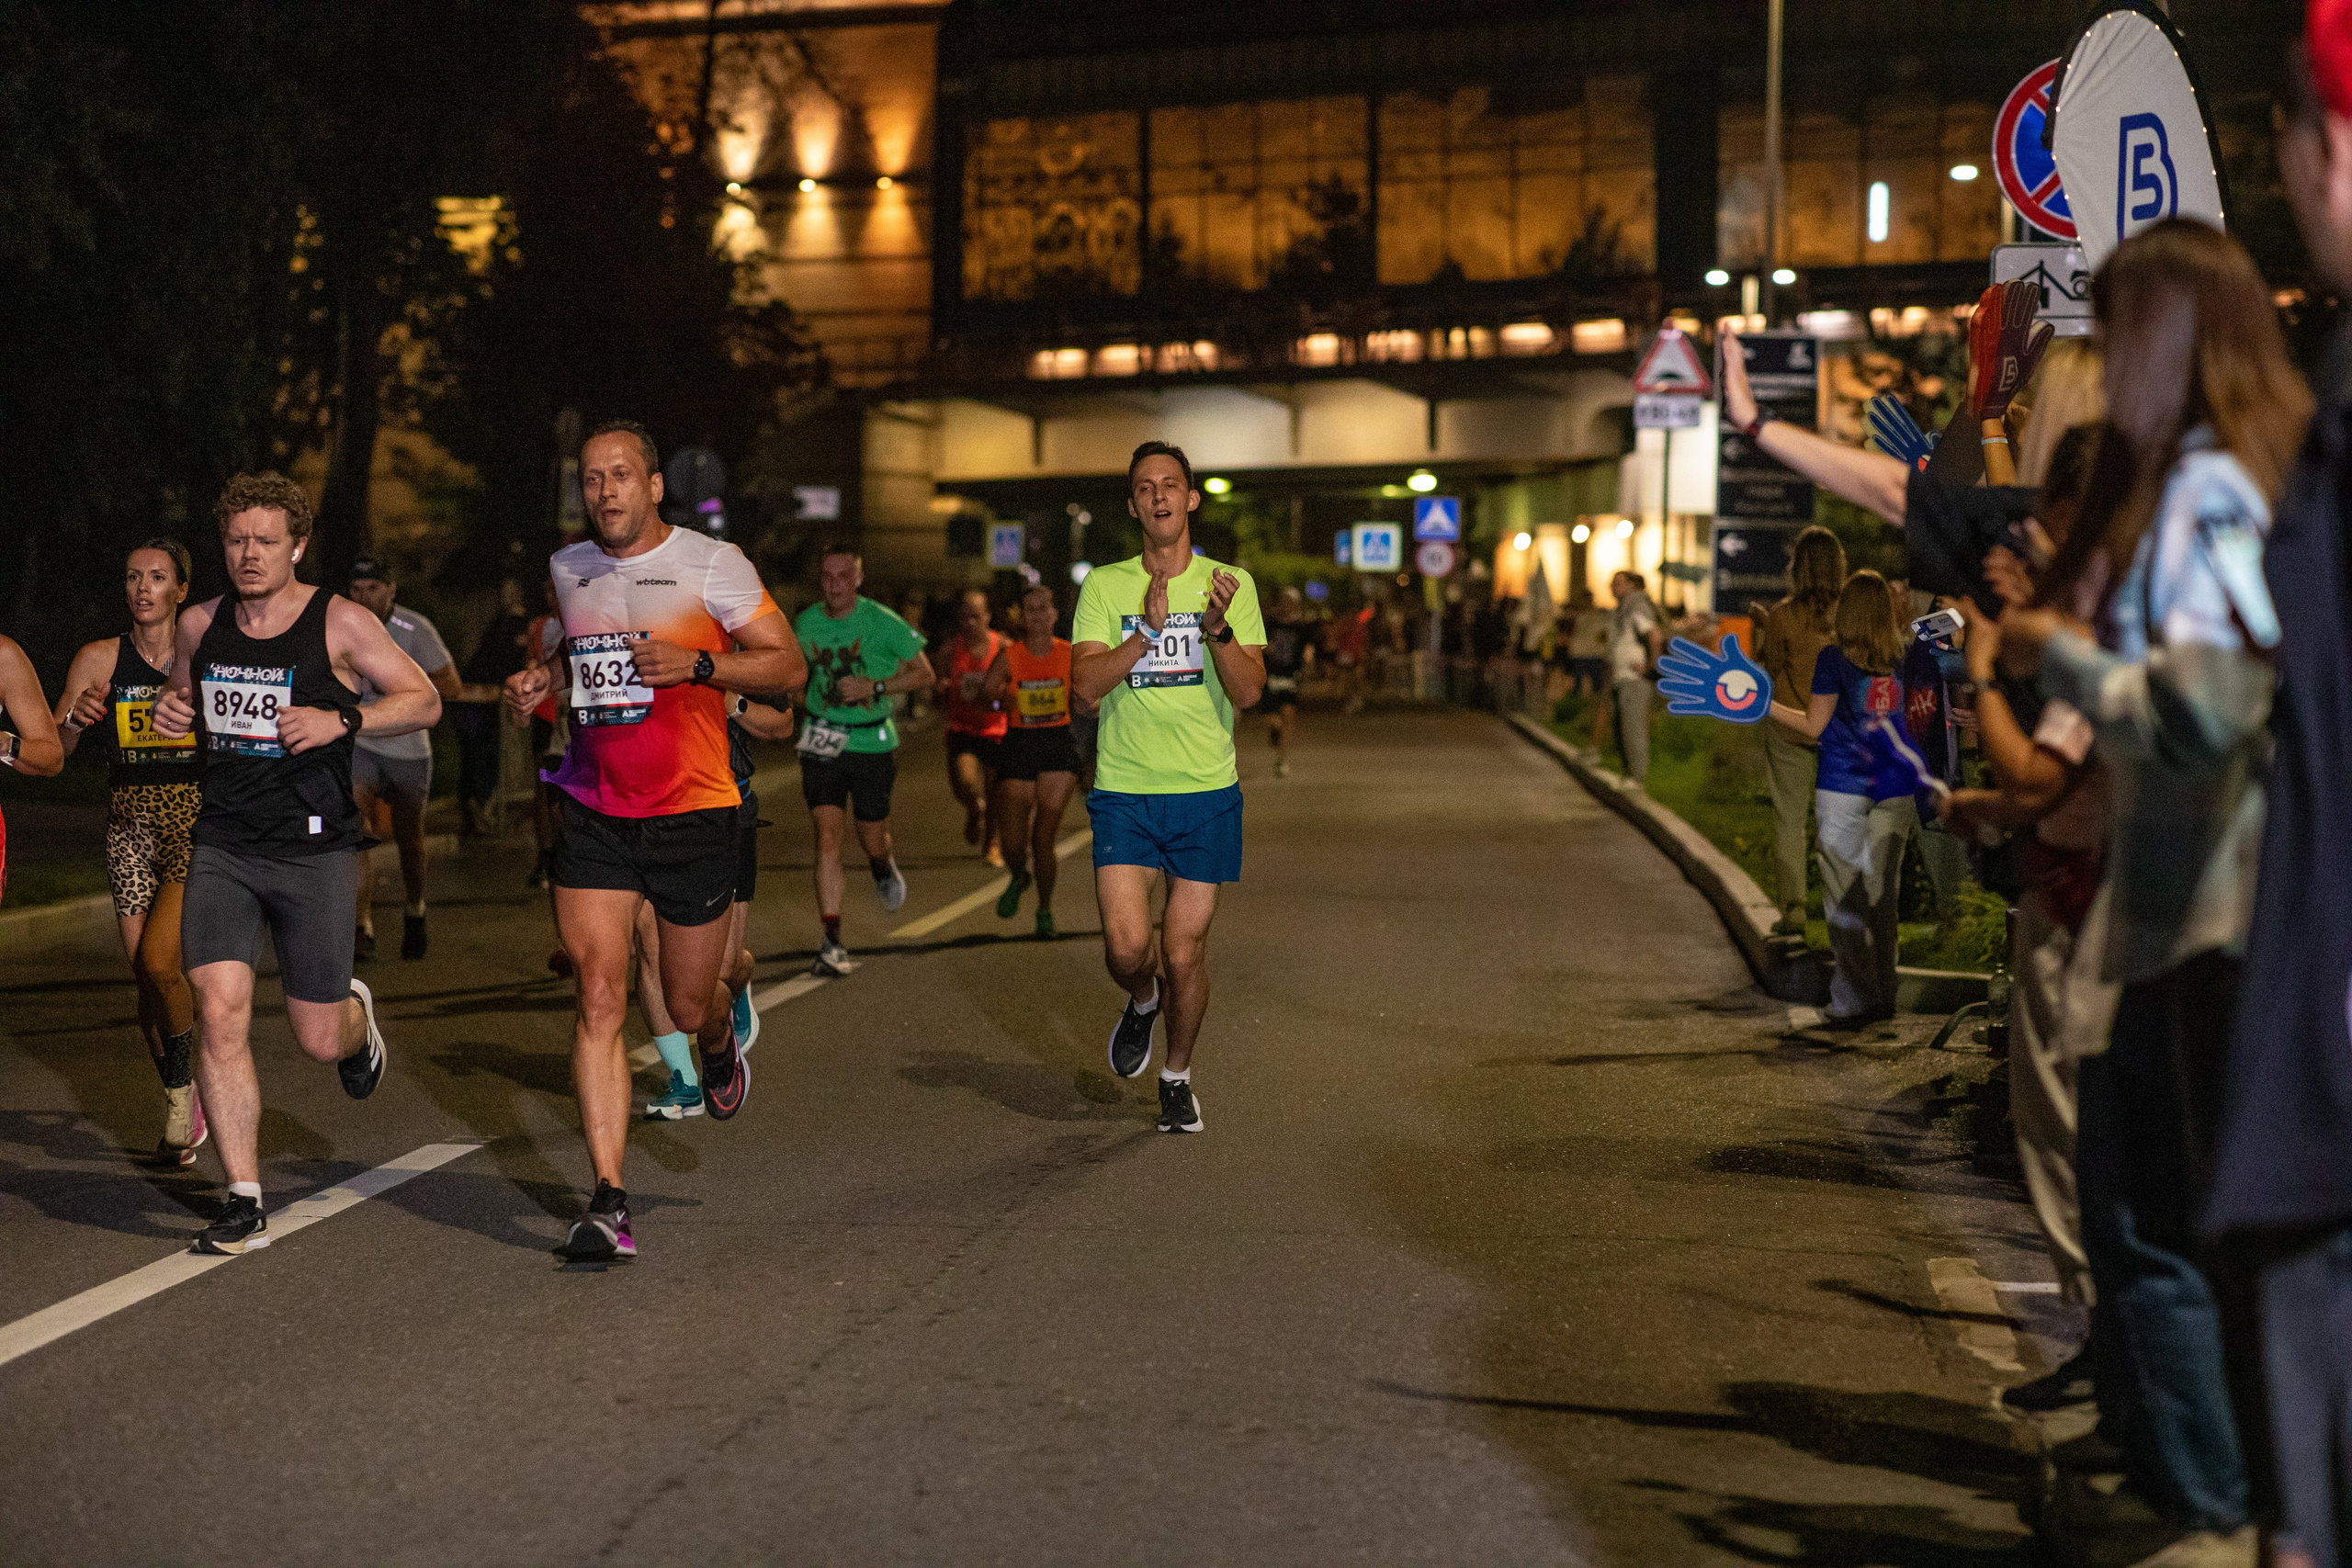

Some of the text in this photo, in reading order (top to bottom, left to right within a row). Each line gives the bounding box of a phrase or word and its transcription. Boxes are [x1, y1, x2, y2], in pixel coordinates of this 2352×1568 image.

[1148, 659, 1179, 667] НИКИТА
[580, 660, 641, 690] 8632
[591, 689, 628, 701] ДМИТРИЙ
[214, 690, 278, 720] 8948
[231, 720, 253, 729] ИВАН
